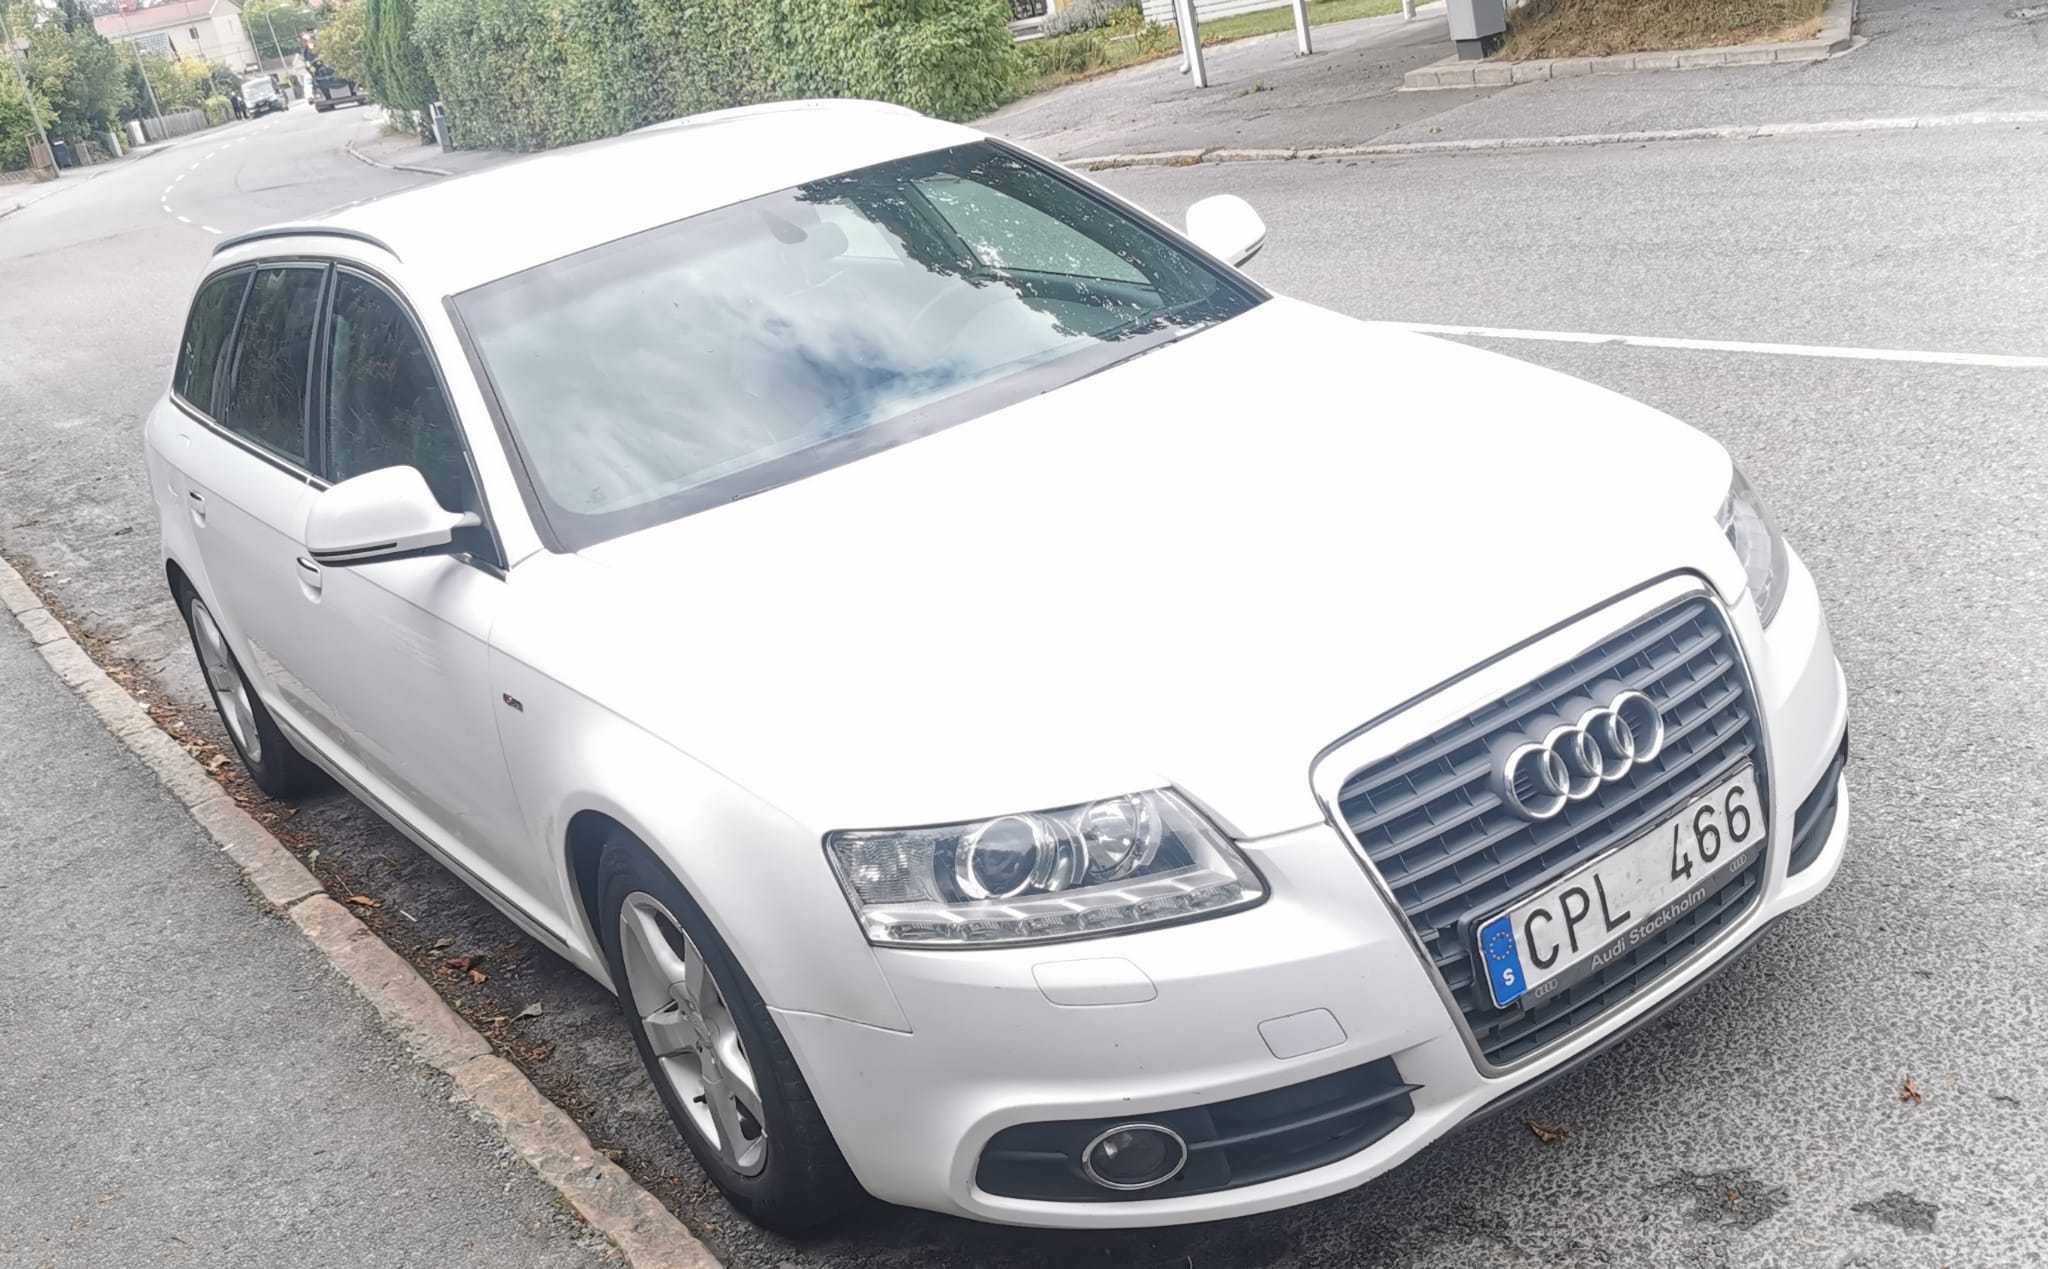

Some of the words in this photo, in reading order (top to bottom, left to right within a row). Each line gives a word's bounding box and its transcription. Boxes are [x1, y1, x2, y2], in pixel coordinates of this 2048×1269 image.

[1524, 873, 1631, 970] CPL
[1670, 785, 1751, 882] 466
[1590, 940, 1627, 970] Audi
[1629, 886, 1706, 945] Stockholm
[1502, 967, 1515, 986] S
